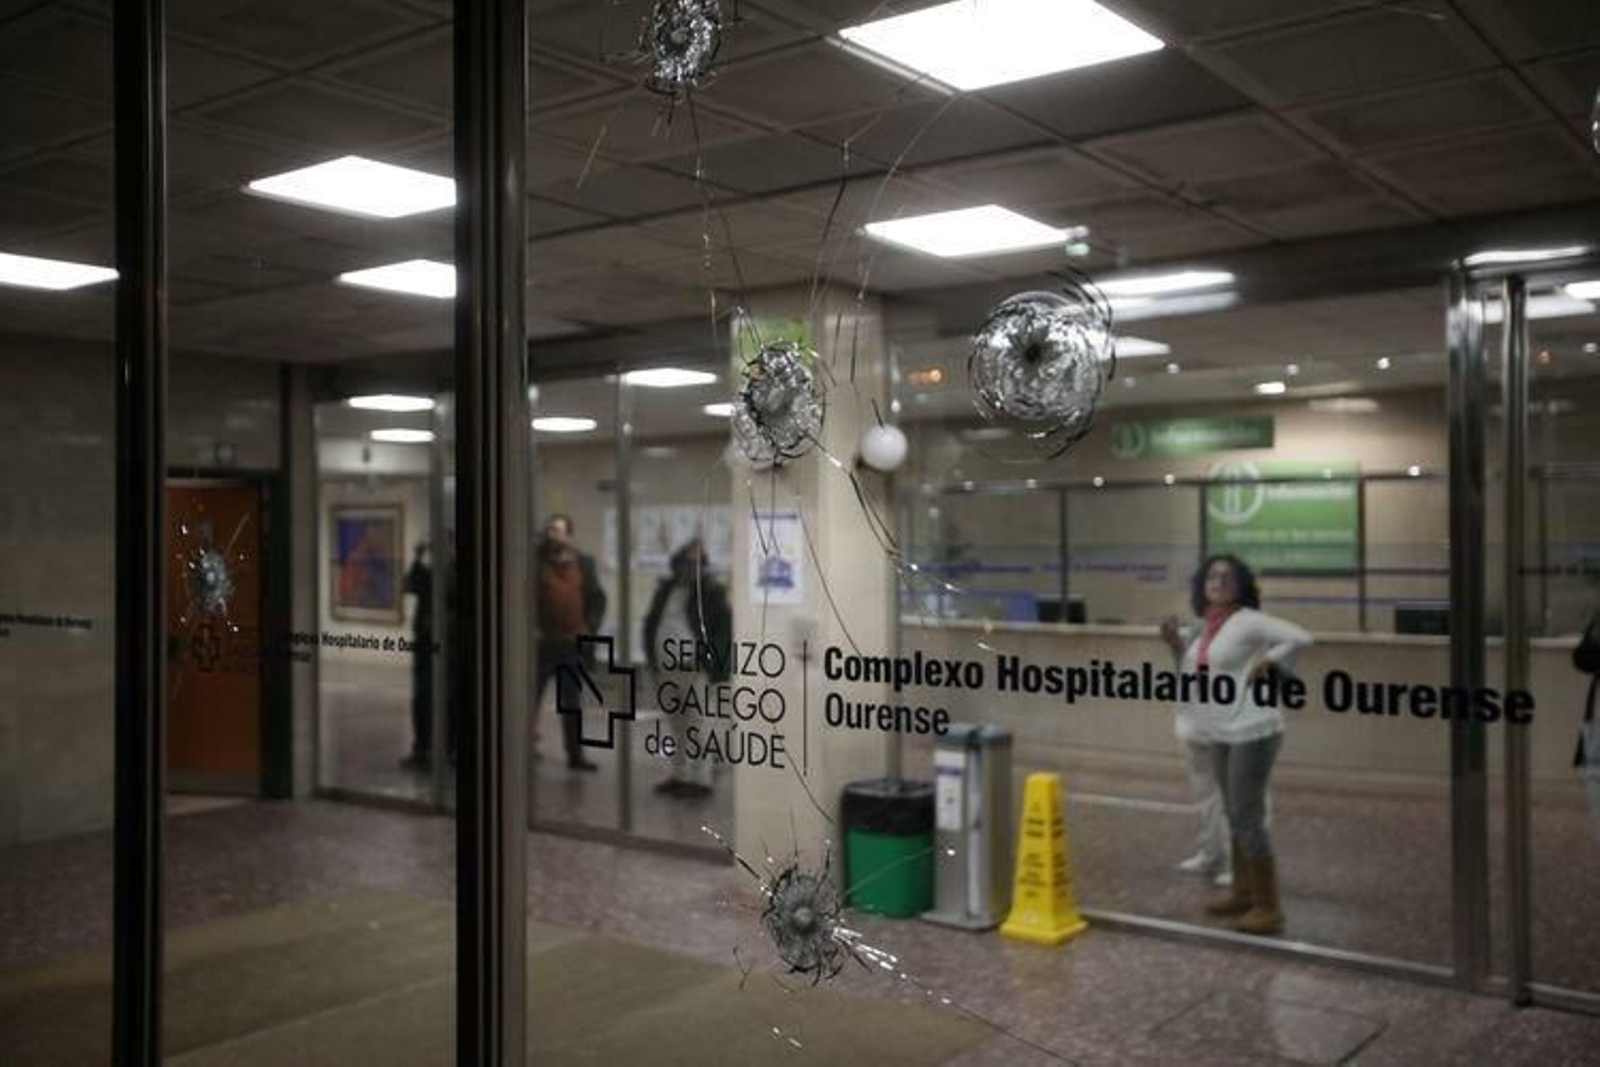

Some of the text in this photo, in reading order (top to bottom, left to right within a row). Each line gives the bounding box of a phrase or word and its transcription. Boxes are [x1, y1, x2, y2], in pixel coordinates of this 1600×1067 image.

[321, 632, 380, 650] Hospitalario
[382, 636, 396, 651] de
[662, 638, 786, 678] SERVIZO
[656, 681, 786, 724] GALEGO
[824, 646, 1535, 724] Complexo Hospitalario de Ourense
[824, 693, 950, 736] Ourense
[645, 719, 786, 769] de SAÚDE
